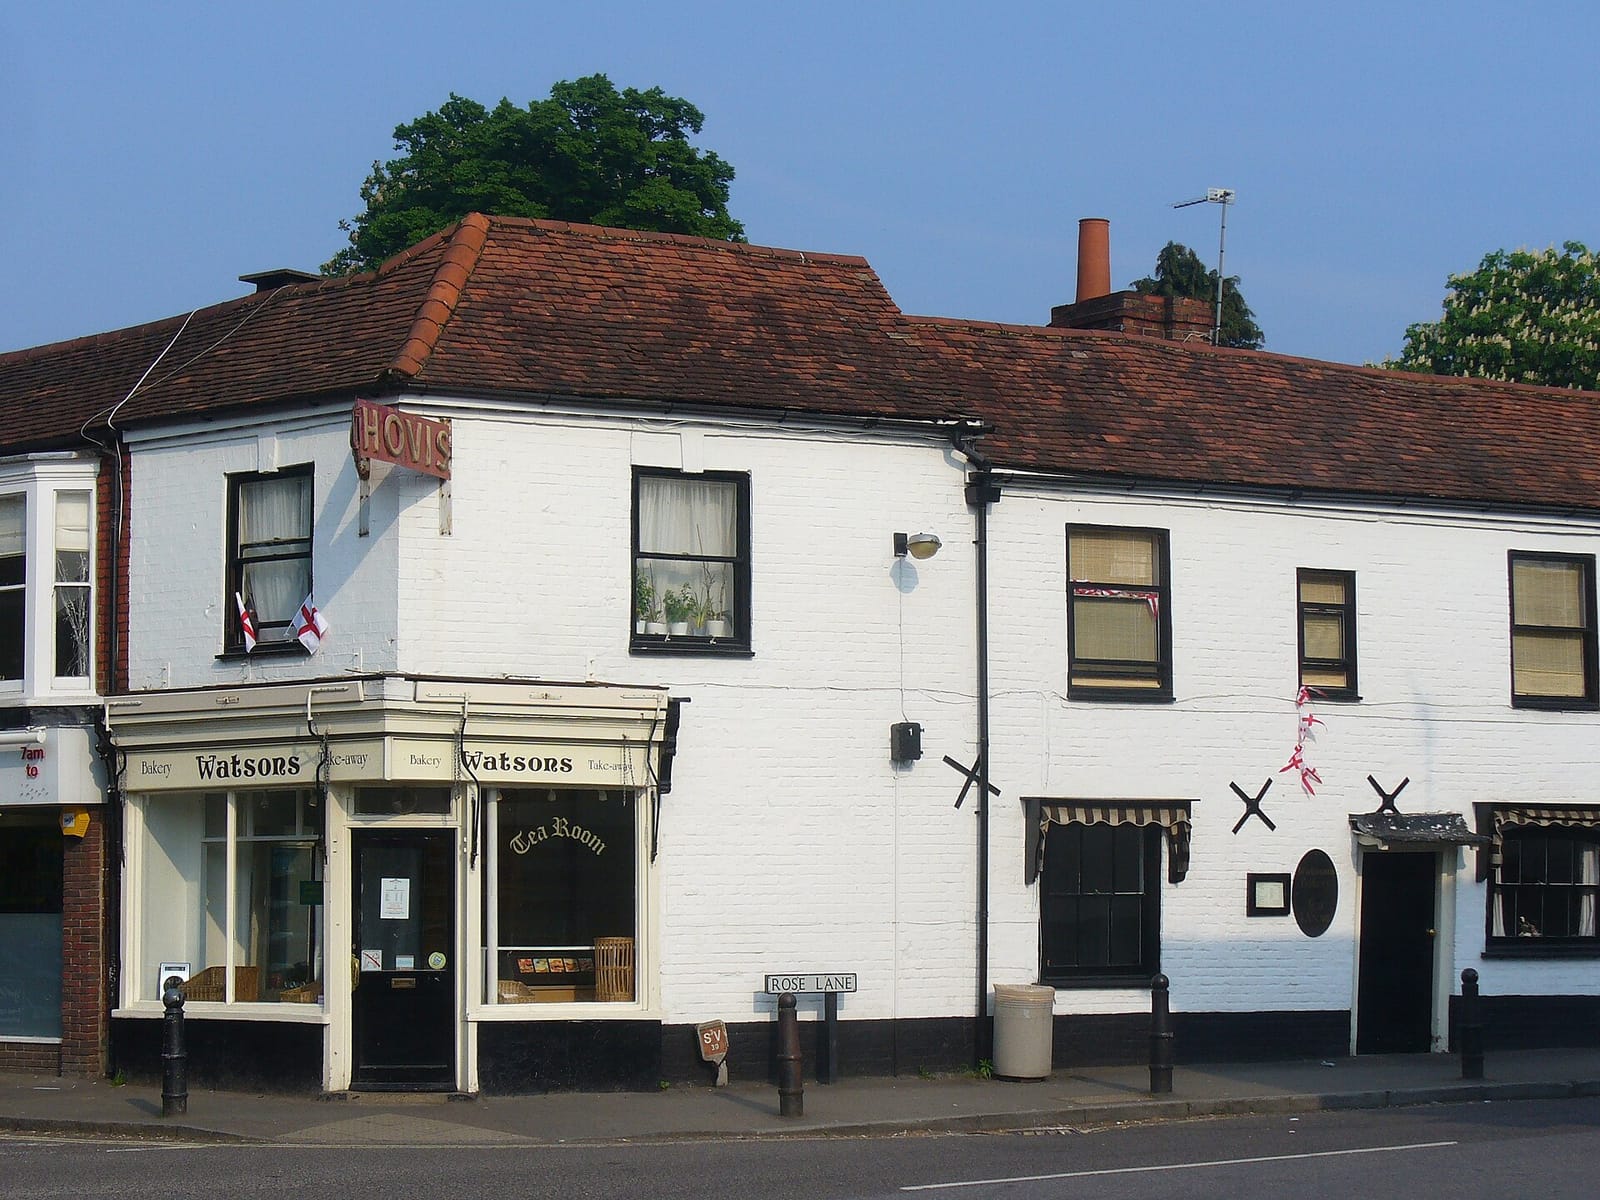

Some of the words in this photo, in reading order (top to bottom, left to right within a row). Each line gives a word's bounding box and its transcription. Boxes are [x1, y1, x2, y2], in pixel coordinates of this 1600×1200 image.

[362, 406, 449, 471] HOVIS
[20, 746, 45, 760] 7am
[409, 754, 442, 769] Bakery
[461, 750, 573, 773] Watsons
[26, 764, 38, 777] to
[141, 760, 172, 779] Bakery
[196, 754, 301, 780] Watsons
[509, 830, 549, 855] Tea
[551, 816, 607, 856] Room
[771, 978, 806, 992] ROSE
[815, 976, 852, 990] LANE
